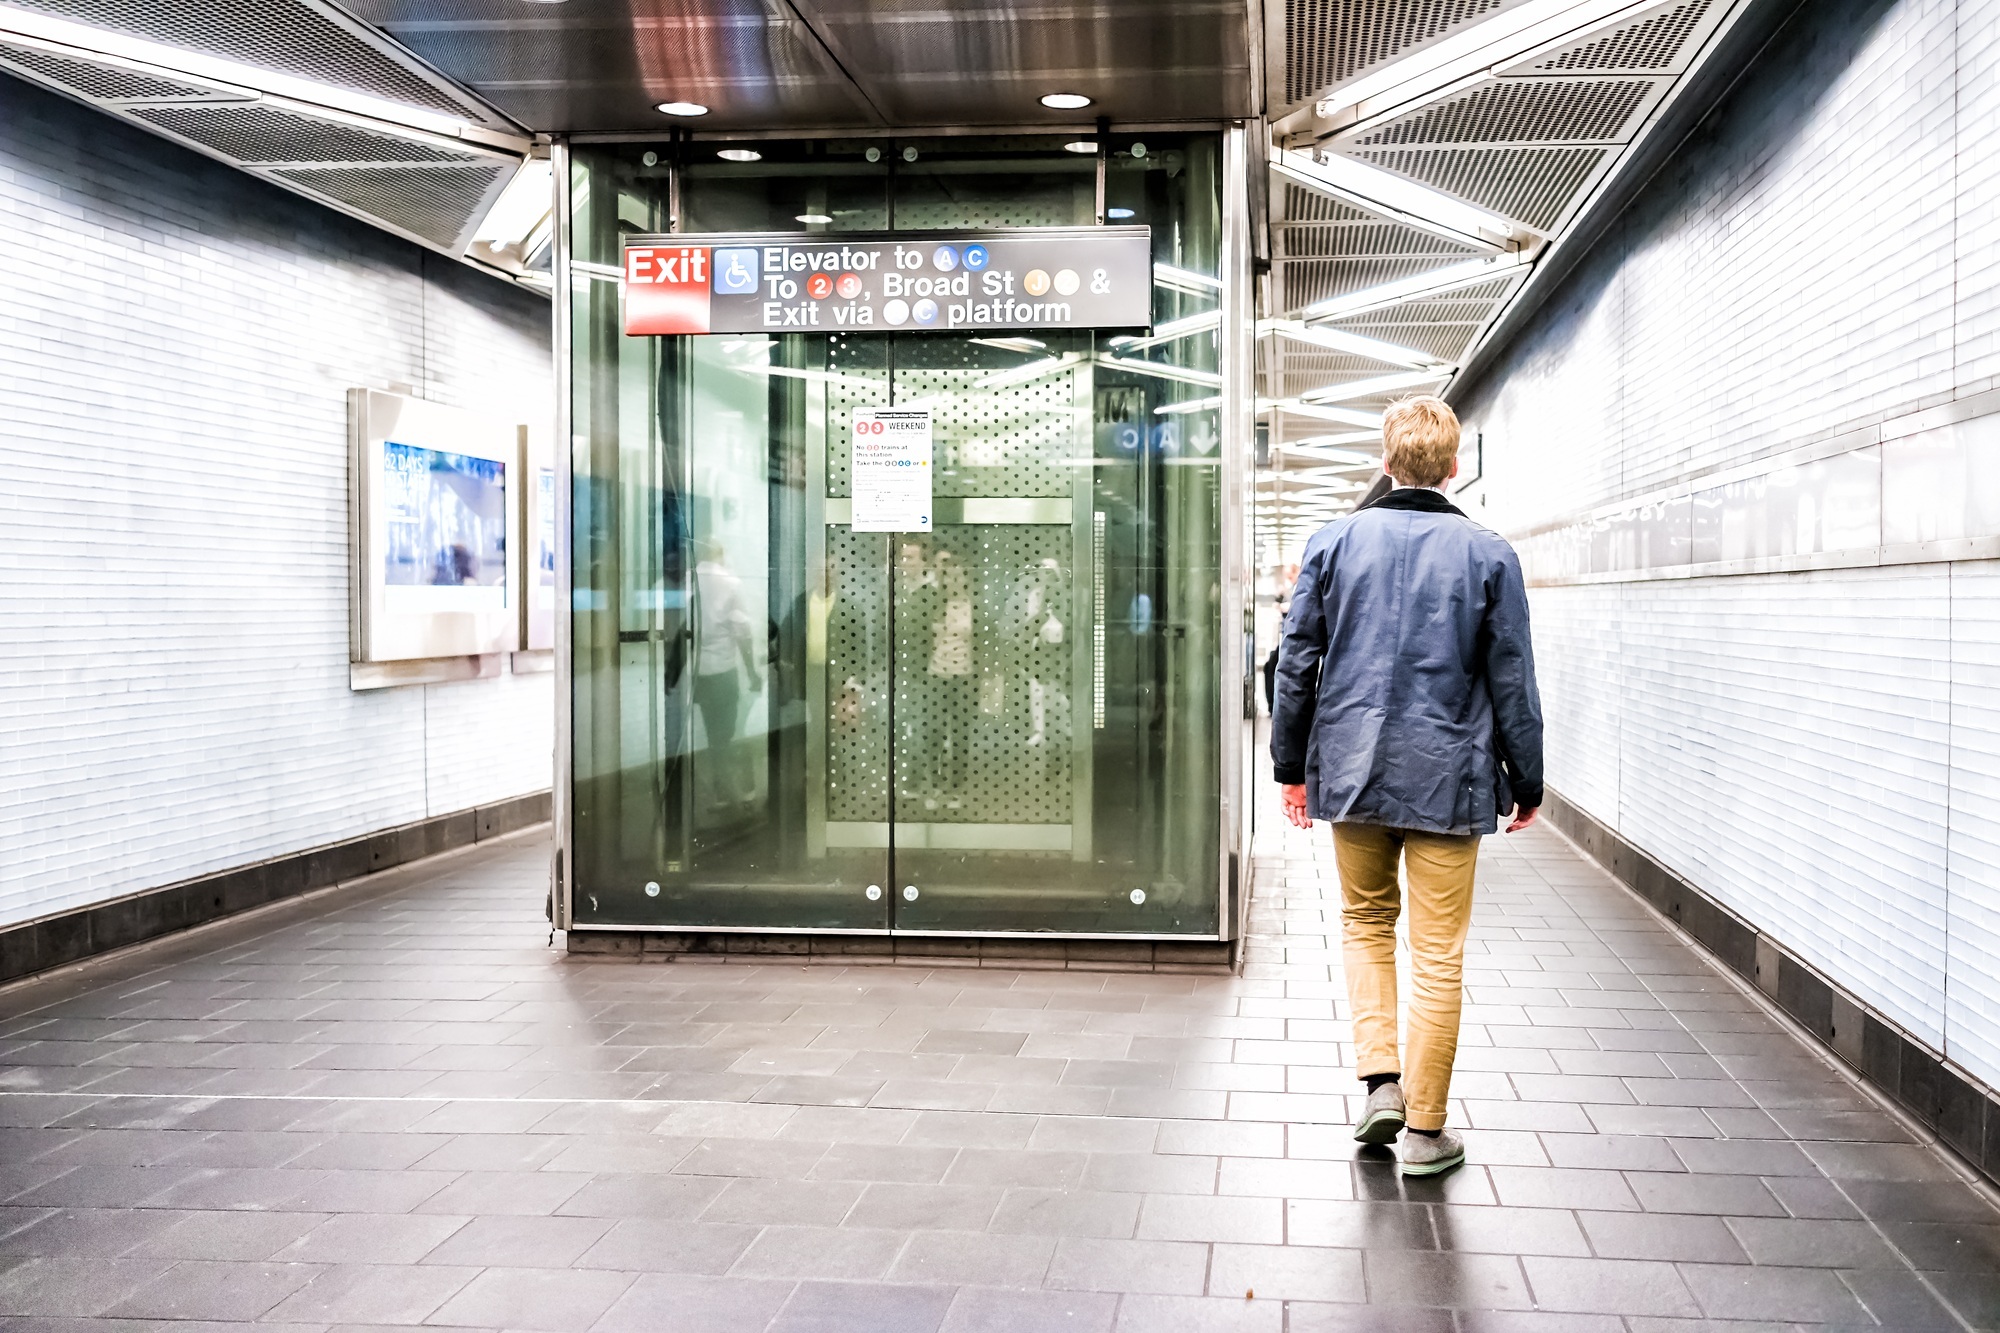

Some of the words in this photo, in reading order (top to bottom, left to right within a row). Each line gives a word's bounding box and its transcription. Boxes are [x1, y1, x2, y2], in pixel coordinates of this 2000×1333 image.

[628, 249, 706, 283] Exit
[763, 246, 881, 272] Elevator
[895, 245, 924, 270] to
[763, 274, 798, 300] To
[883, 270, 970, 297] Broad
[982, 270, 1015, 296] St
[1089, 267, 1111, 295] &
[763, 300, 820, 327] Exit
[832, 300, 874, 326] via
[948, 298, 1071, 328] platform
[889, 422, 926, 430] WEEKEND
[385, 453, 396, 470] 62
[398, 454, 423, 473] DAYS
